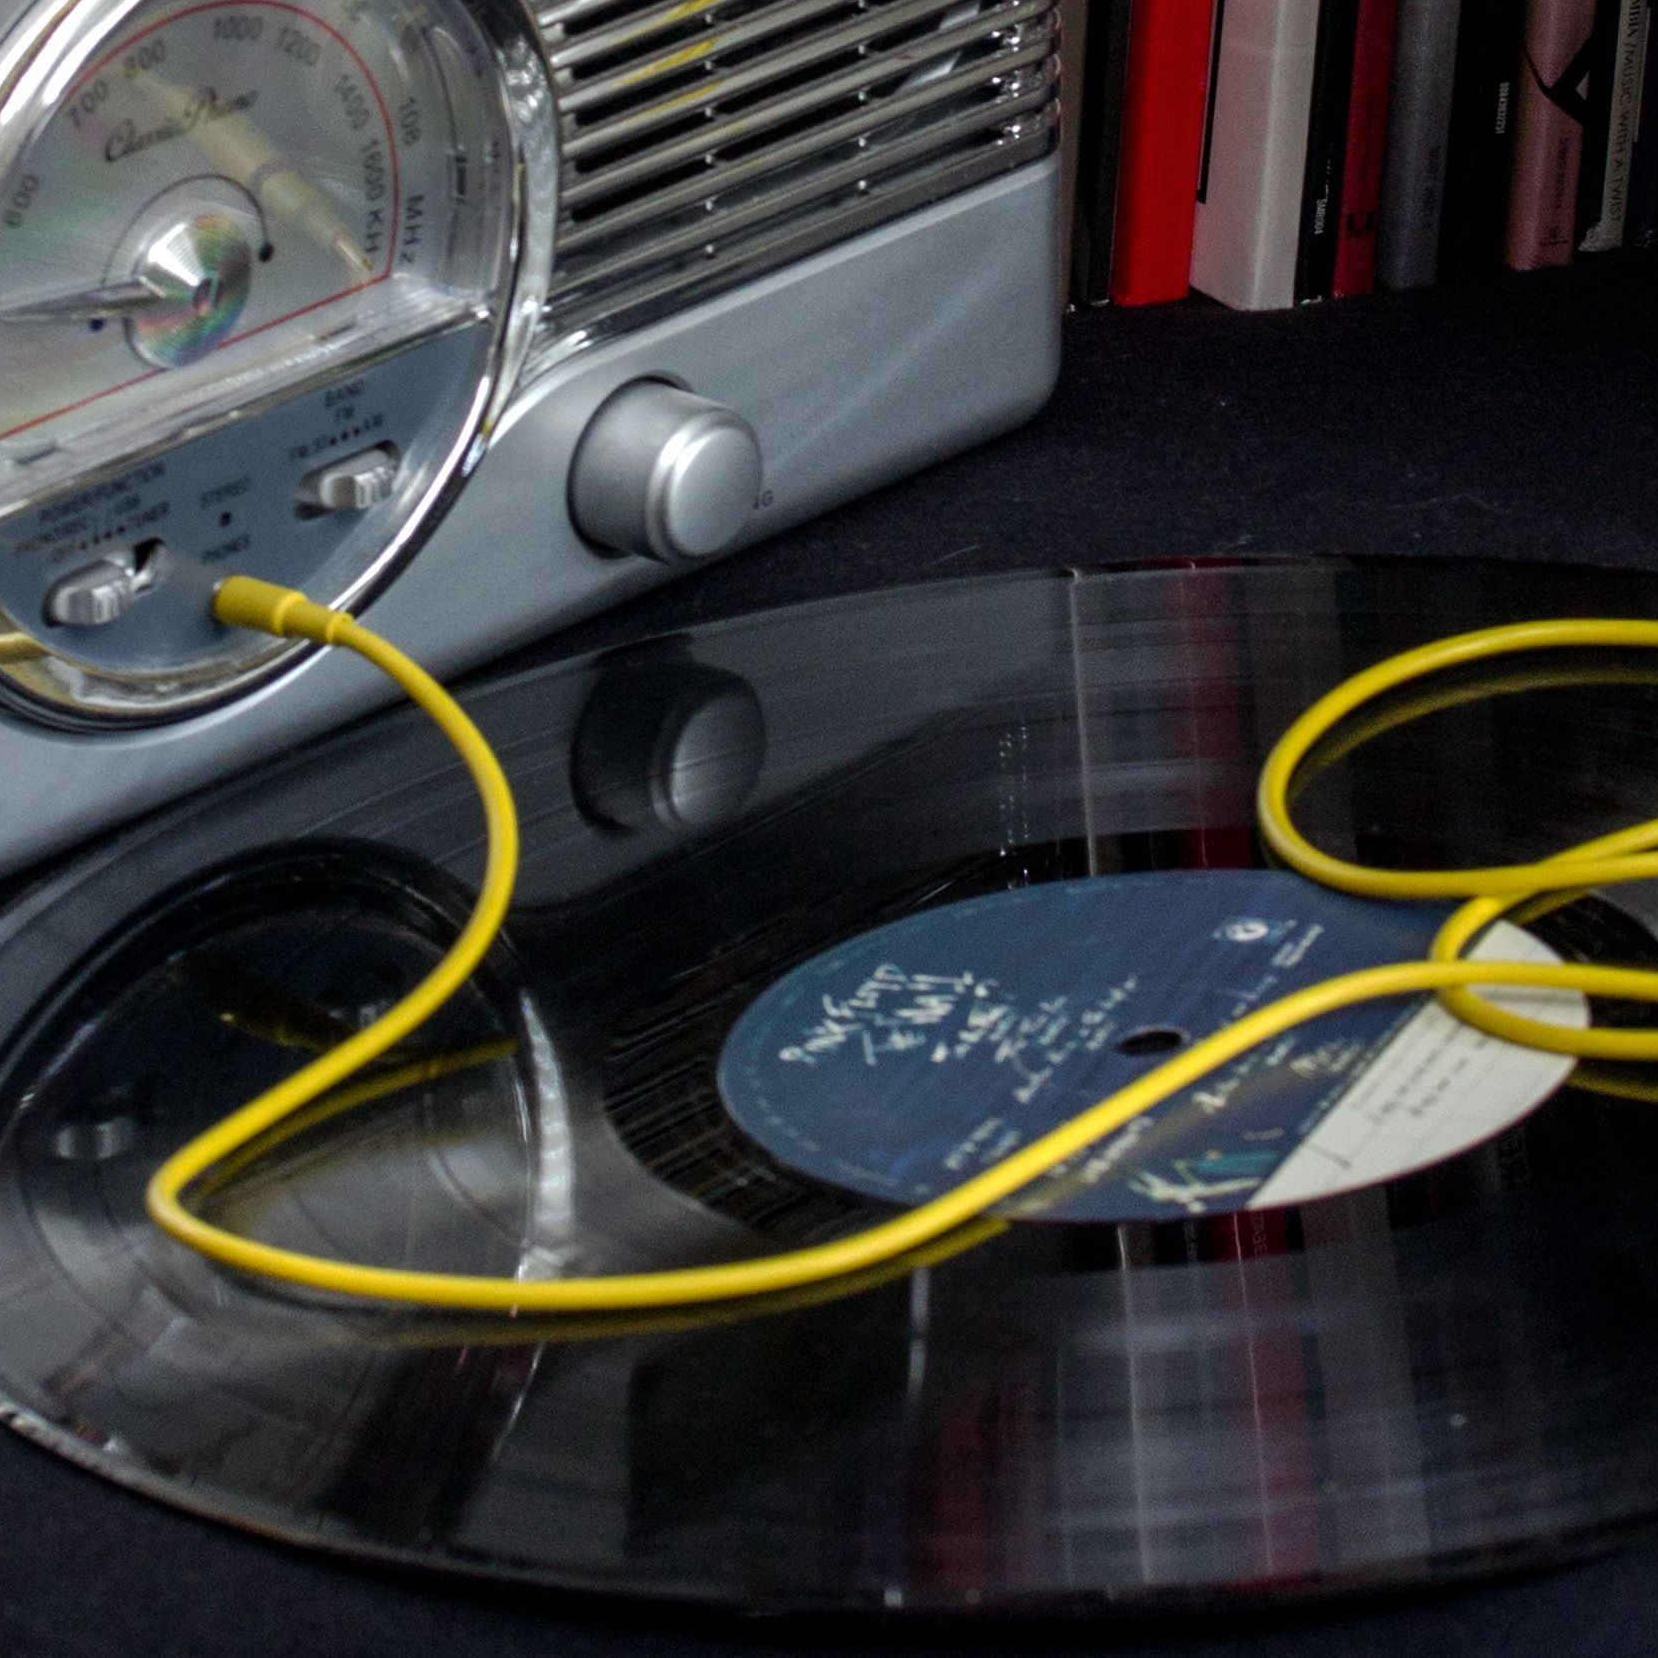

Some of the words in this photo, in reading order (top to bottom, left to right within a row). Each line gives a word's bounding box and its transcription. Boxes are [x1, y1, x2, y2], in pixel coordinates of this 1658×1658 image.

[3, 174, 39, 228] 600
[68, 79, 110, 130] 700
[121, 40, 168, 81] 800
[211, 13, 264, 40] 1000
[279, 26, 322, 68] 1200
[336, 73, 370, 132] 1400
[398, 194, 426, 264] MHz
